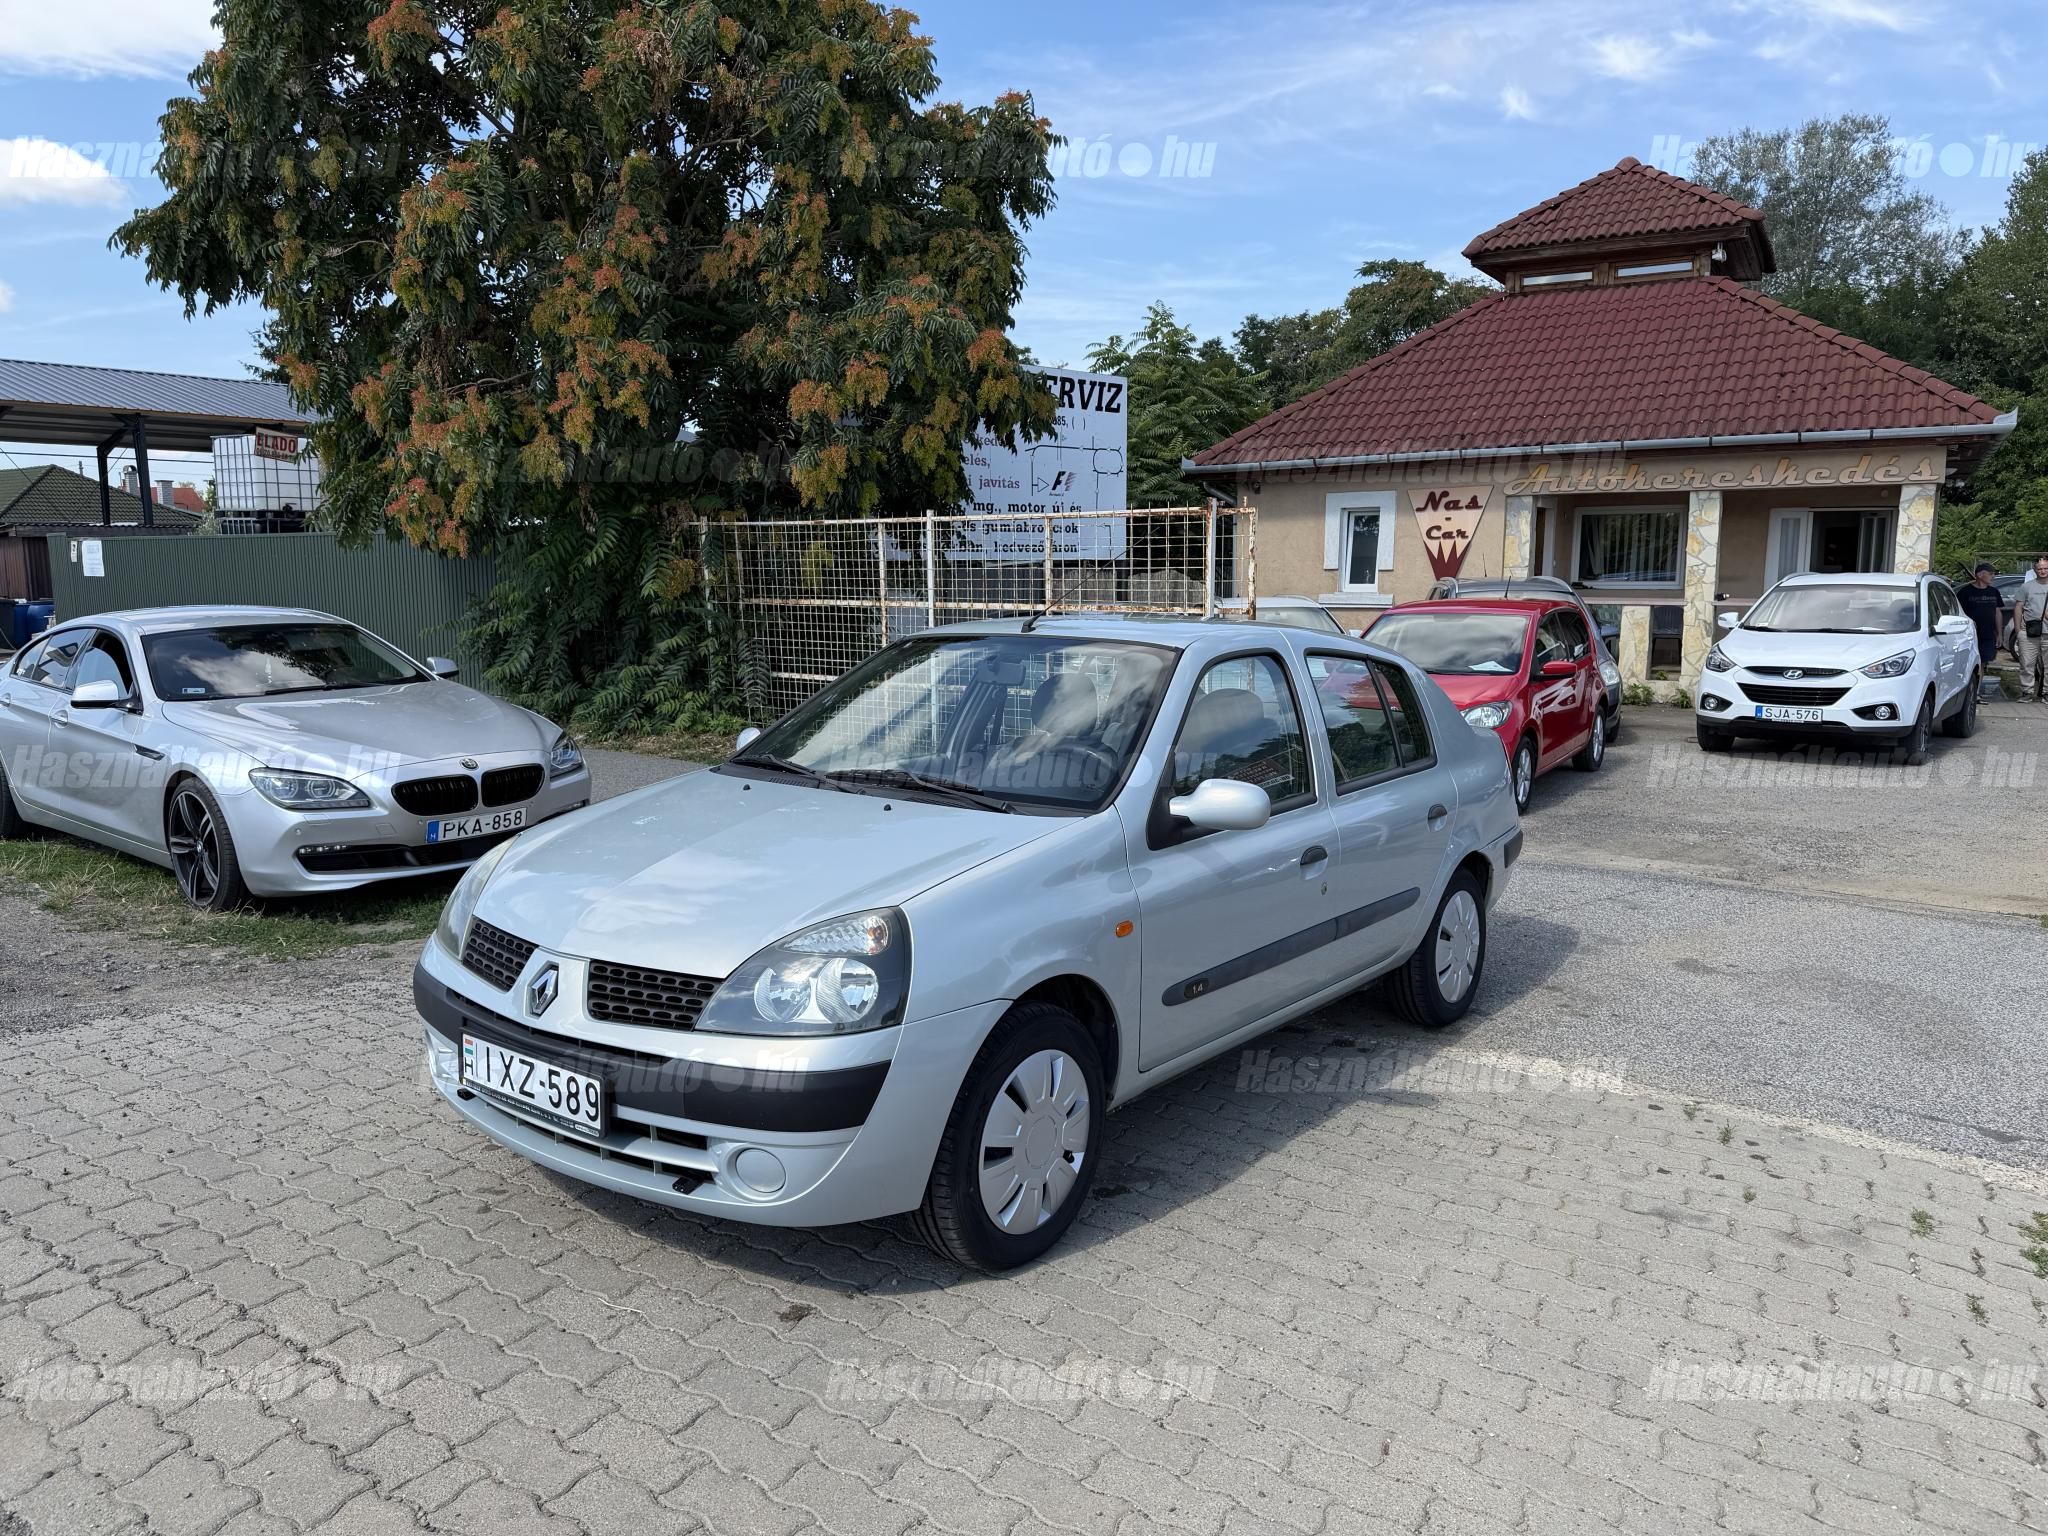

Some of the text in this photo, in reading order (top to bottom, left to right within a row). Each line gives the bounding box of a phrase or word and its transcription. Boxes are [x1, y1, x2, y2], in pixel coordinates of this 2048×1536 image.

[979, 475, 1020, 490] javítás
[1503, 455, 1939, 496] Autókereskedés
[1008, 503, 1046, 514] motor
[1416, 491, 1484, 513] Nas
[982, 520, 1078, 535] gumiabrocsok
[1425, 524, 1470, 541] Car
[1765, 708, 1819, 721] SJA-576
[443, 810, 523, 839] PKA-858
[486, 1046, 599, 1122] IXZ-589
